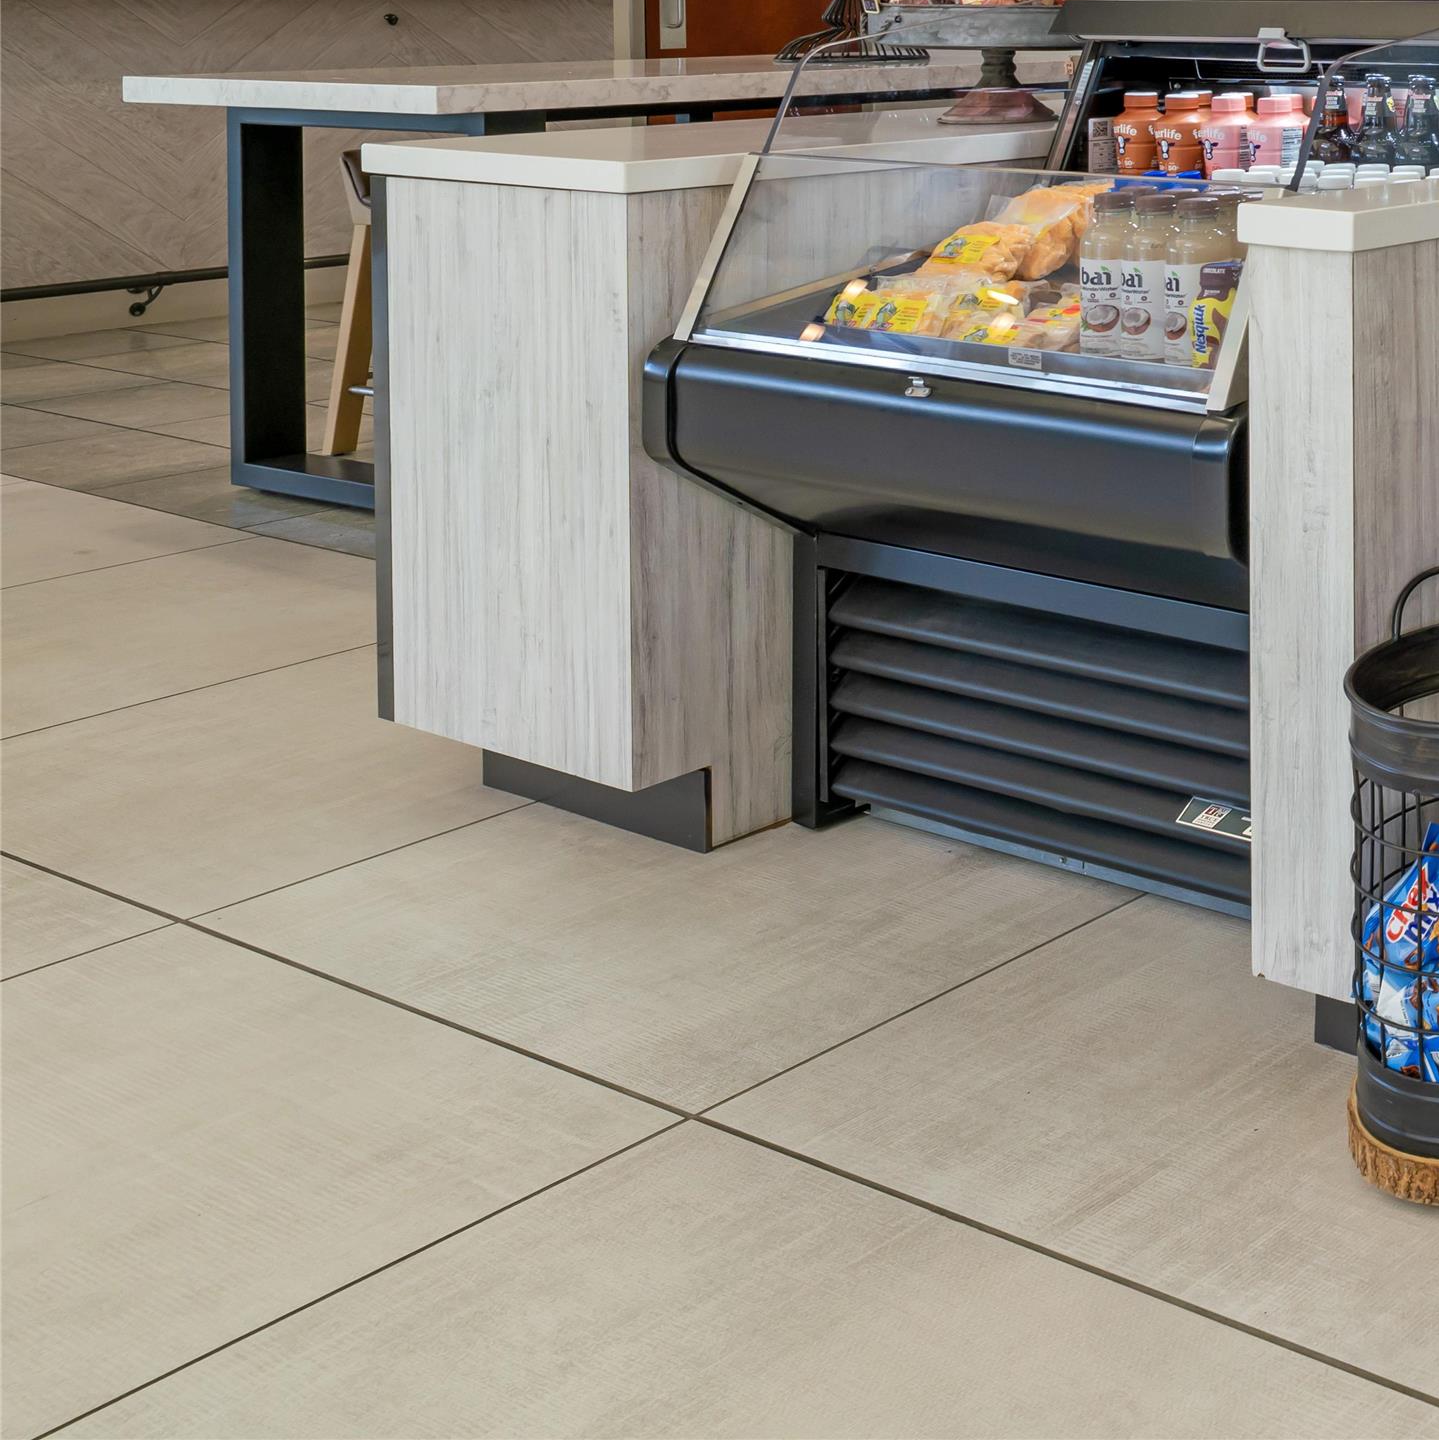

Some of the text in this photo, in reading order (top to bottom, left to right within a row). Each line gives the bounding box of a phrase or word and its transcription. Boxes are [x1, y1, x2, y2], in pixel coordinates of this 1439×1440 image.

[1081, 267, 1111, 286] bai
[1166, 277, 1180, 292] ai
[1194, 304, 1209, 354] Nesquik
